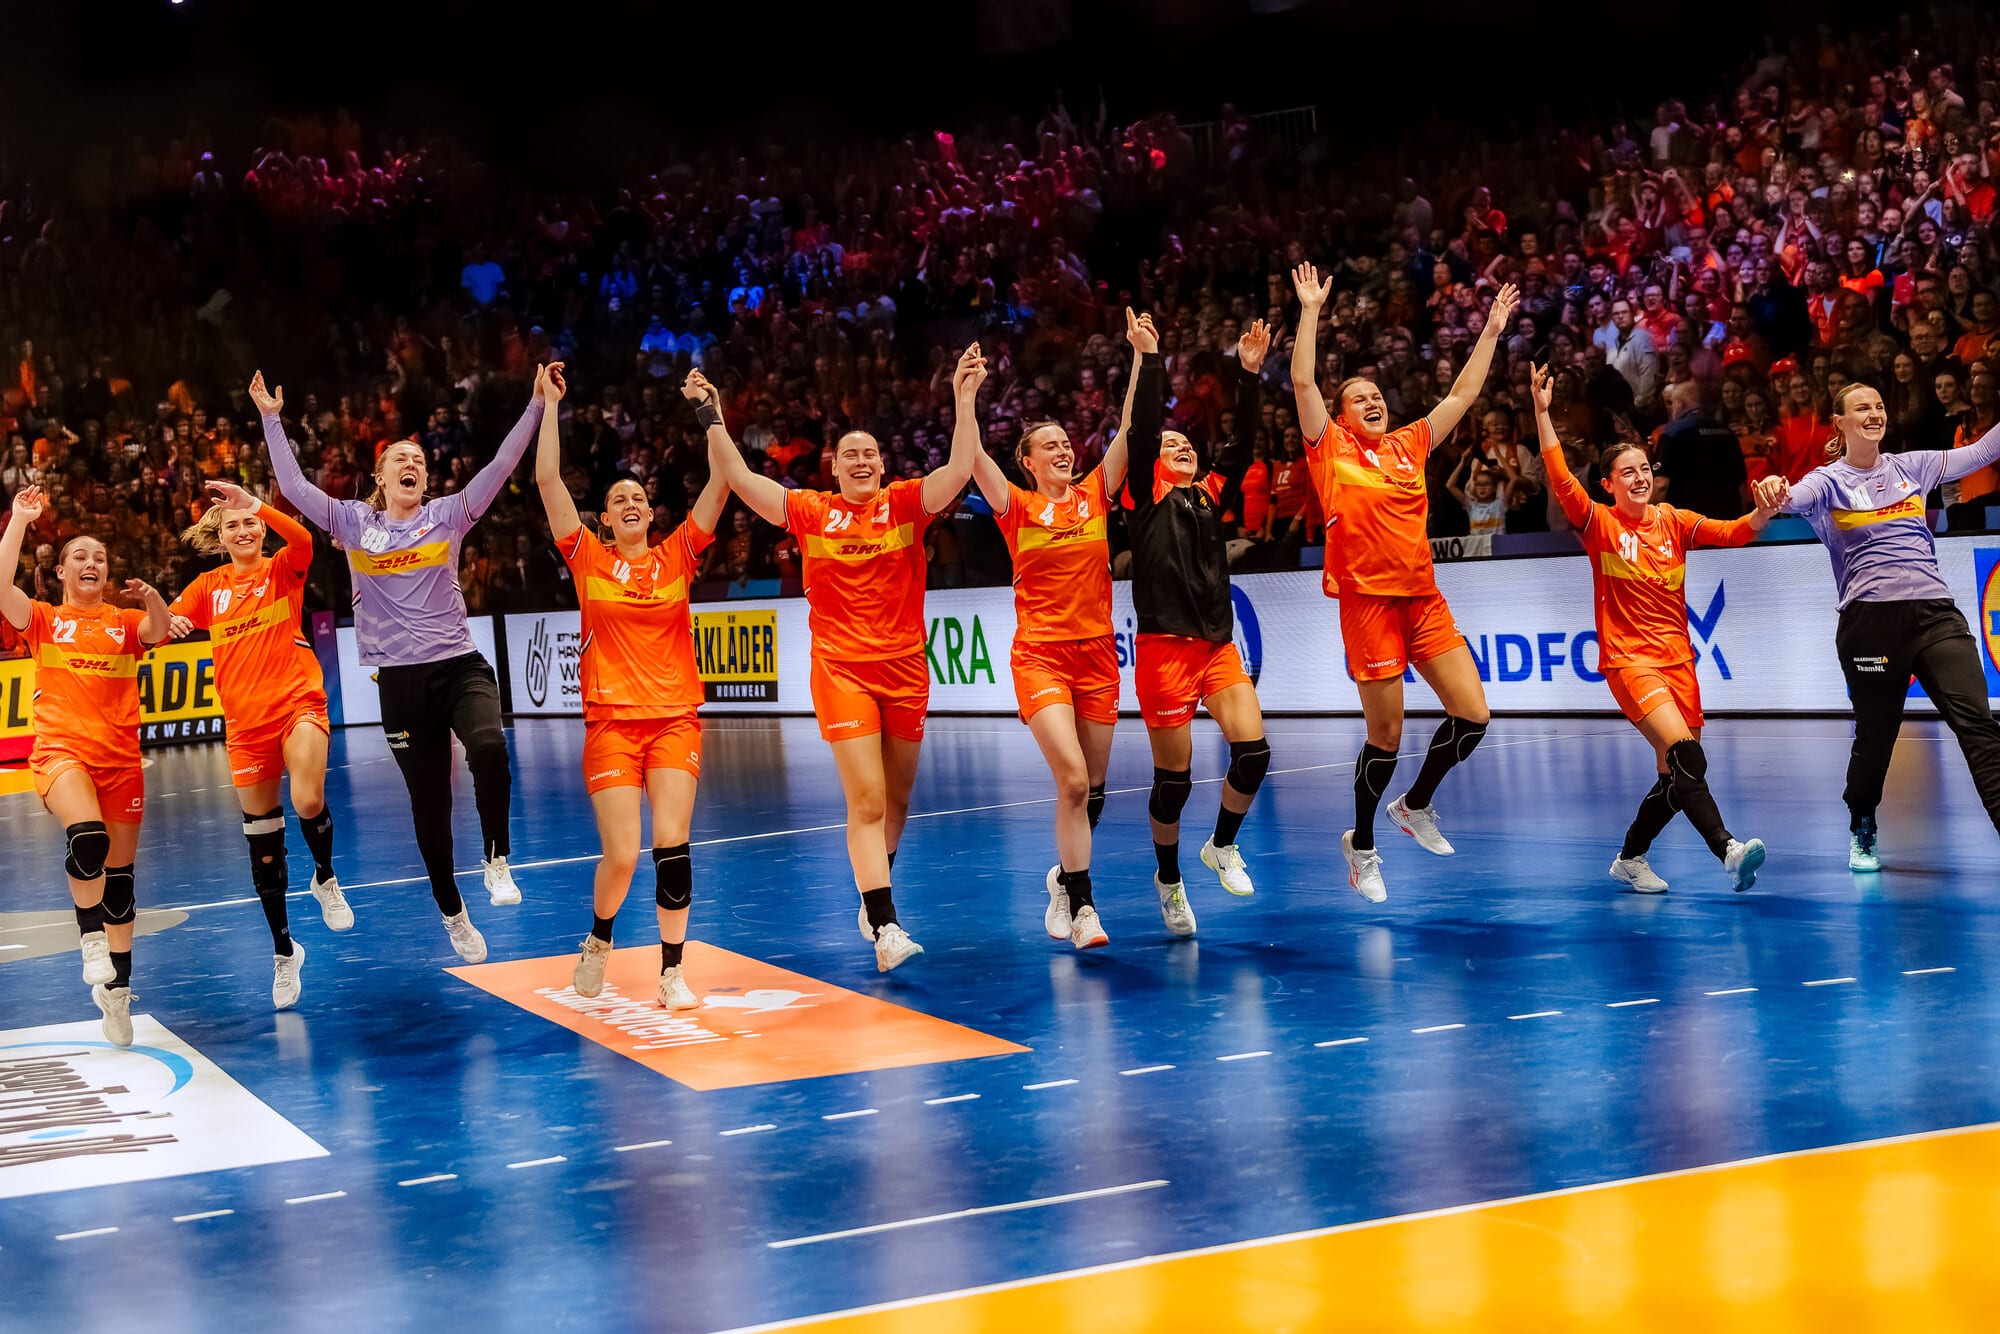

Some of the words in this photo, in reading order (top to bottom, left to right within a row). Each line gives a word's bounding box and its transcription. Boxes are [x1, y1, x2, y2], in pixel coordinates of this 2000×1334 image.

[824, 508, 854, 532] 24
[1038, 502, 1055, 526] 4
[359, 526, 391, 553] 88
[1050, 527, 1092, 541] DHL
[1618, 532, 1639, 562] 31
[211, 588, 233, 617] 19
[52, 616, 78, 643] 22
[224, 617, 263, 638] DHL
[68, 658, 113, 672] DHL
[1855, 664, 1886, 672] TeamNL
[0, 677, 28, 728] L
[716, 684, 767, 698] WORKWEAR
